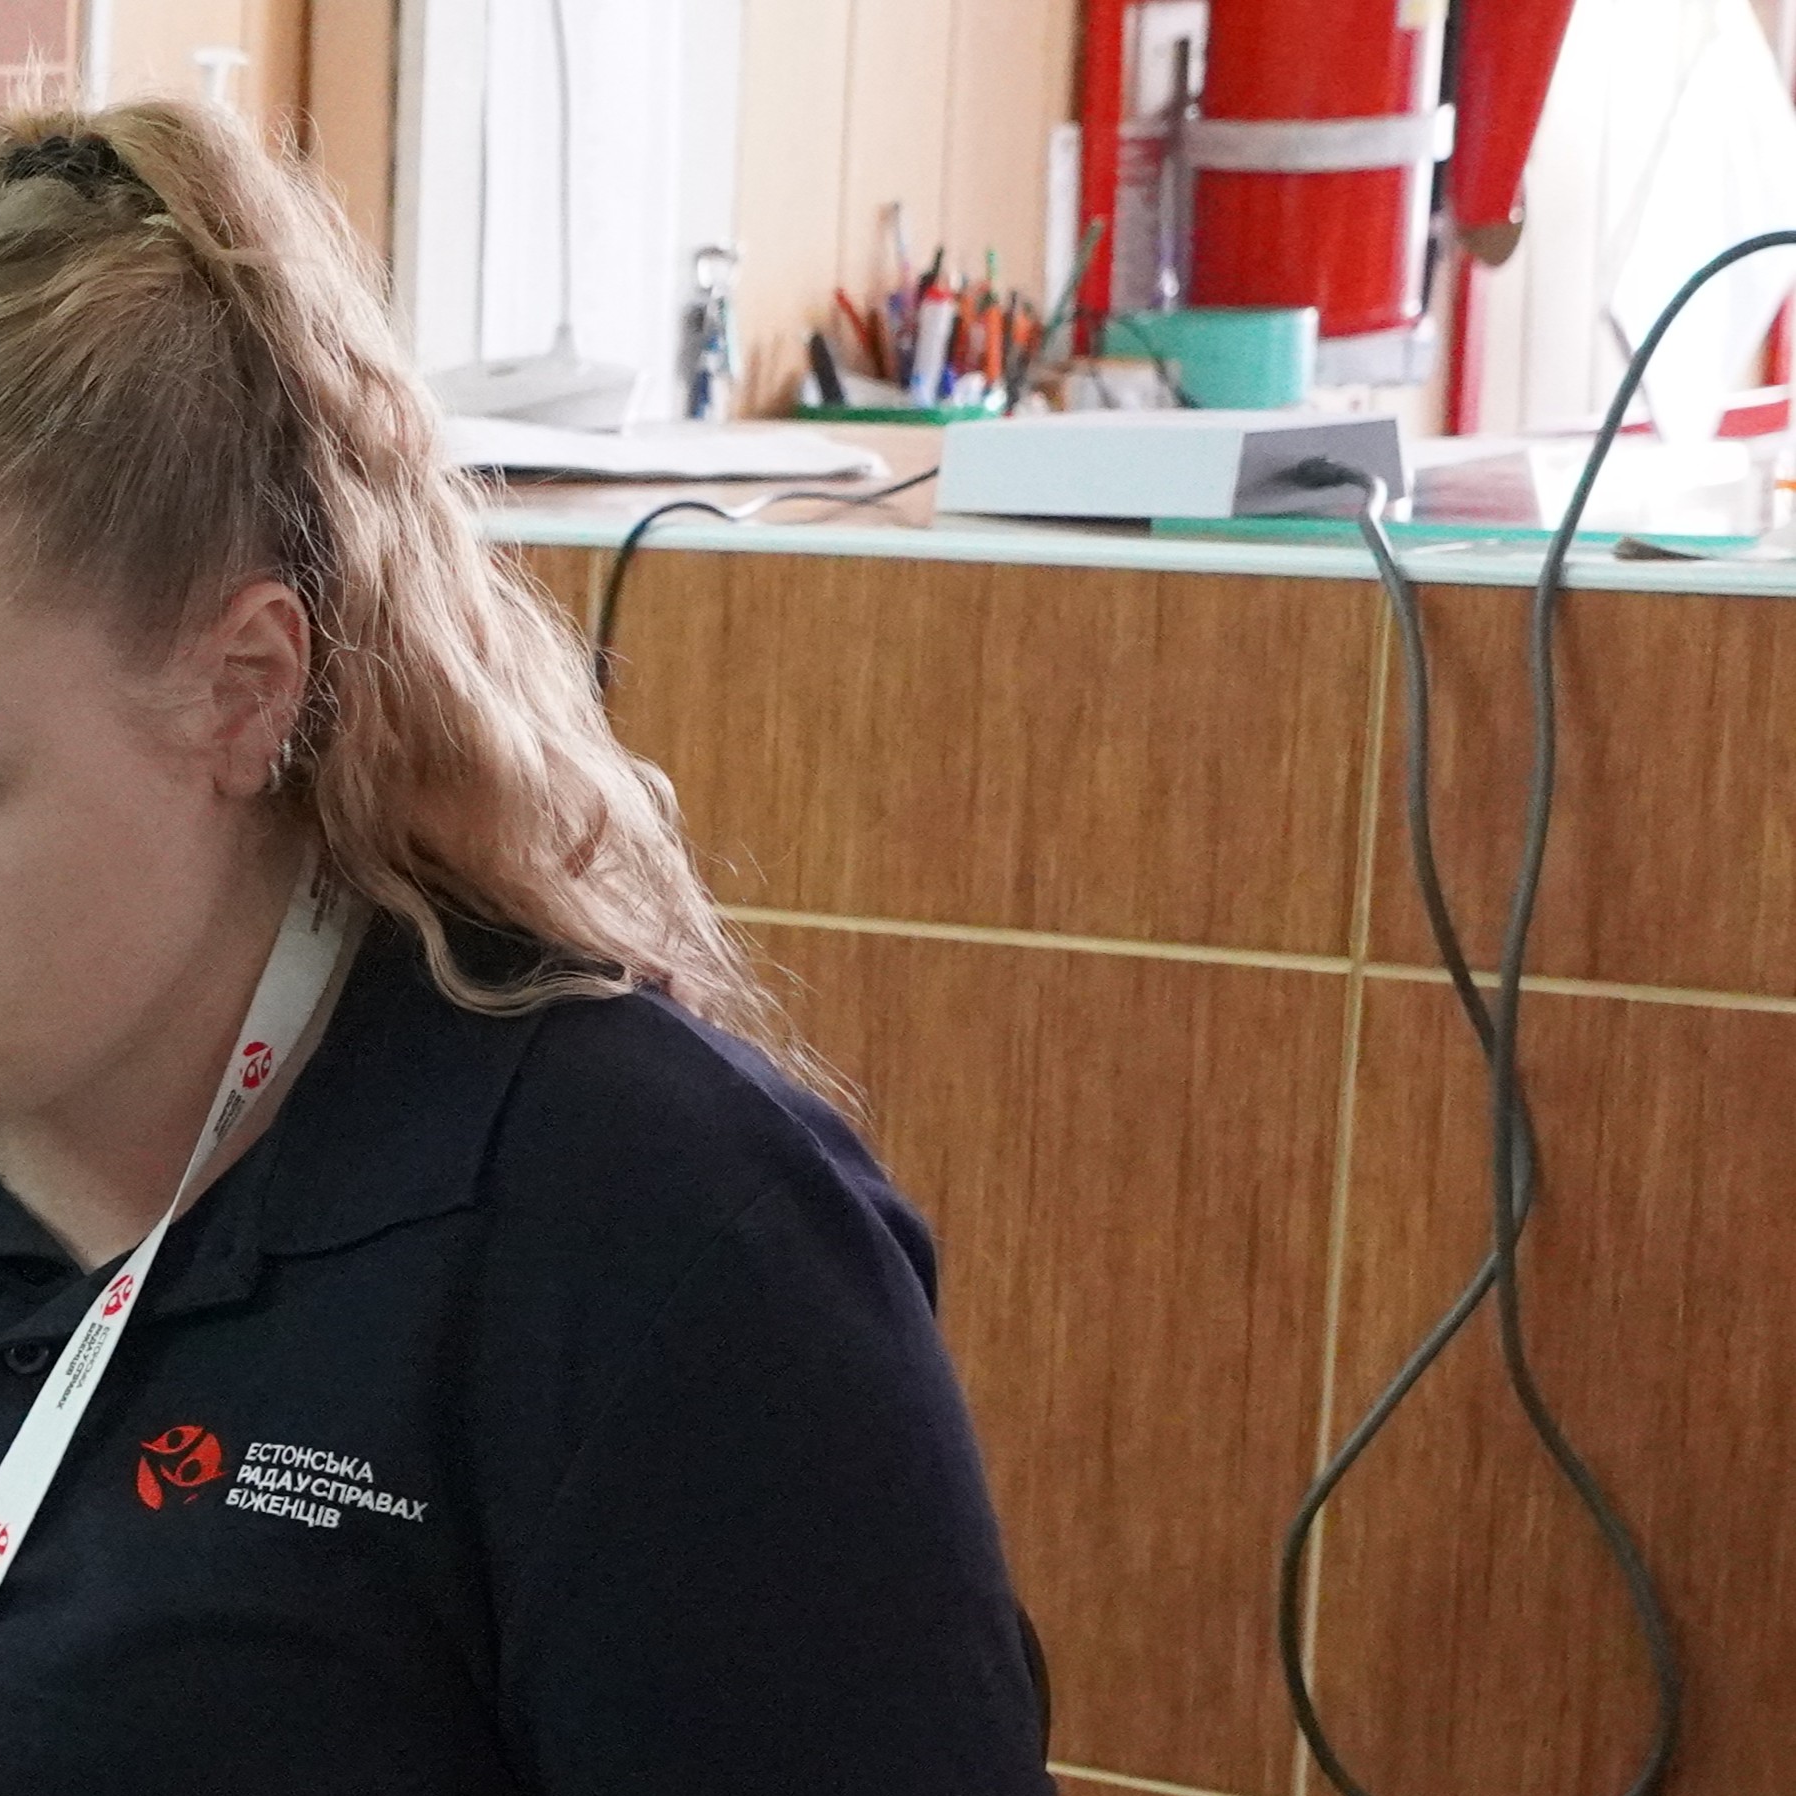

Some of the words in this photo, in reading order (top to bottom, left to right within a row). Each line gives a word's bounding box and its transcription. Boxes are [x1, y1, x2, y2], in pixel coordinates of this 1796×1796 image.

[244, 1441, 375, 1484] ЕСТОНСЬКА
[225, 1487, 342, 1529] БІЖЕНЦІВ
[236, 1464, 296, 1493] РАДА
[310, 1476, 429, 1522] СПРАВАХ
